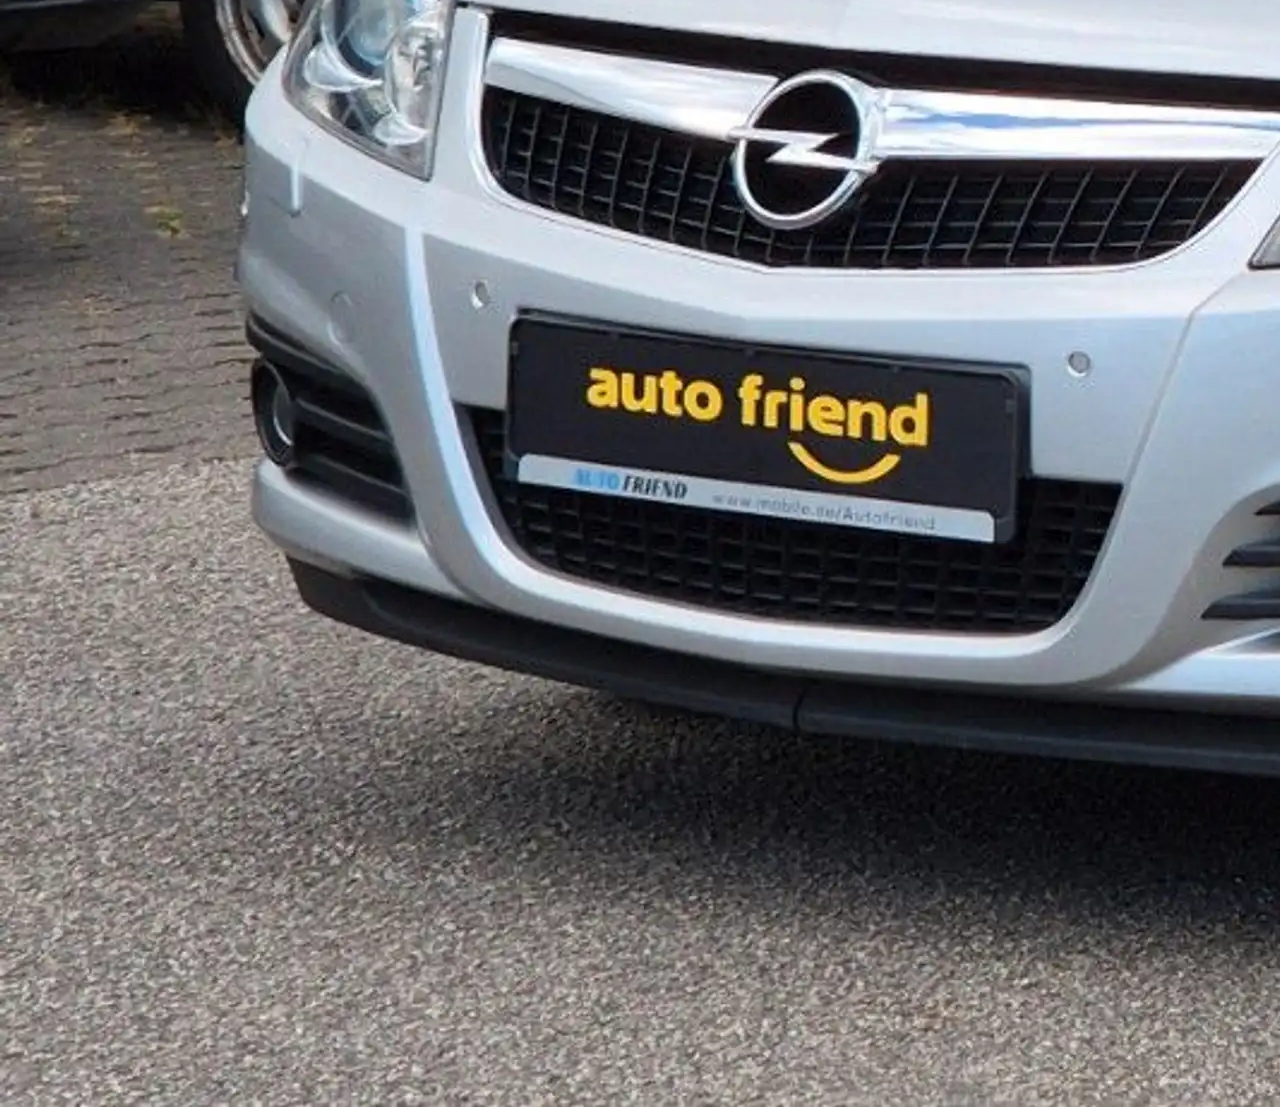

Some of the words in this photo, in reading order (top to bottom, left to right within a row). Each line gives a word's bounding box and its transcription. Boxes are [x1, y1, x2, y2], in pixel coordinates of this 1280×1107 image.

[586, 367, 723, 422] auto
[738, 373, 930, 447] friend
[575, 468, 621, 490] AUTO
[622, 474, 689, 500] FRIEND
